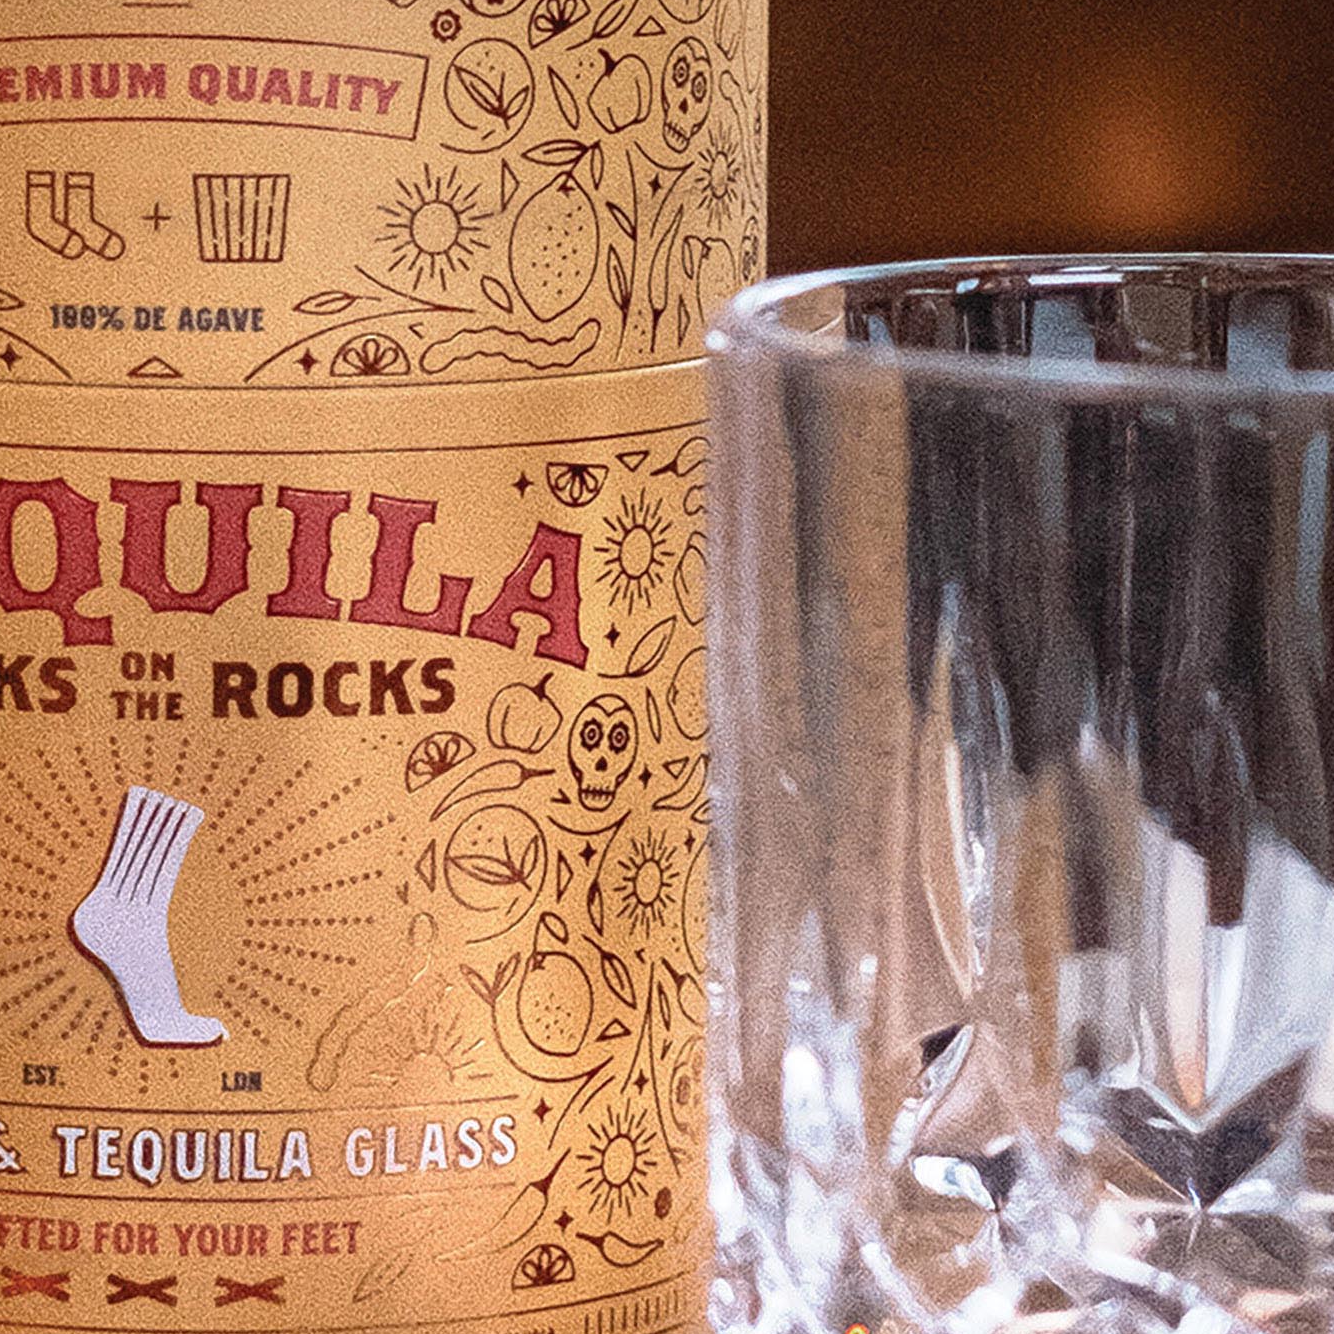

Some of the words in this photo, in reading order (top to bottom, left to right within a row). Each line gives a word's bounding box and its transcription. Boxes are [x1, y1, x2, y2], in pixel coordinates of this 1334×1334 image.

[187, 62, 403, 116] QUALITY
[49, 304, 122, 331] 100%
[134, 306, 165, 332] DE
[178, 307, 265, 334] AGAVE
[122, 650, 176, 682] ON
[110, 689, 185, 722] THE
[210, 657, 457, 720] ROCKS
[55, 1124, 314, 1187] TEQUILA
[343, 1113, 520, 1177] GLASS
[94, 1221, 160, 1257] FOR
[176, 1221, 269, 1258] YOUR
[281, 1220, 364, 1256] FEET
